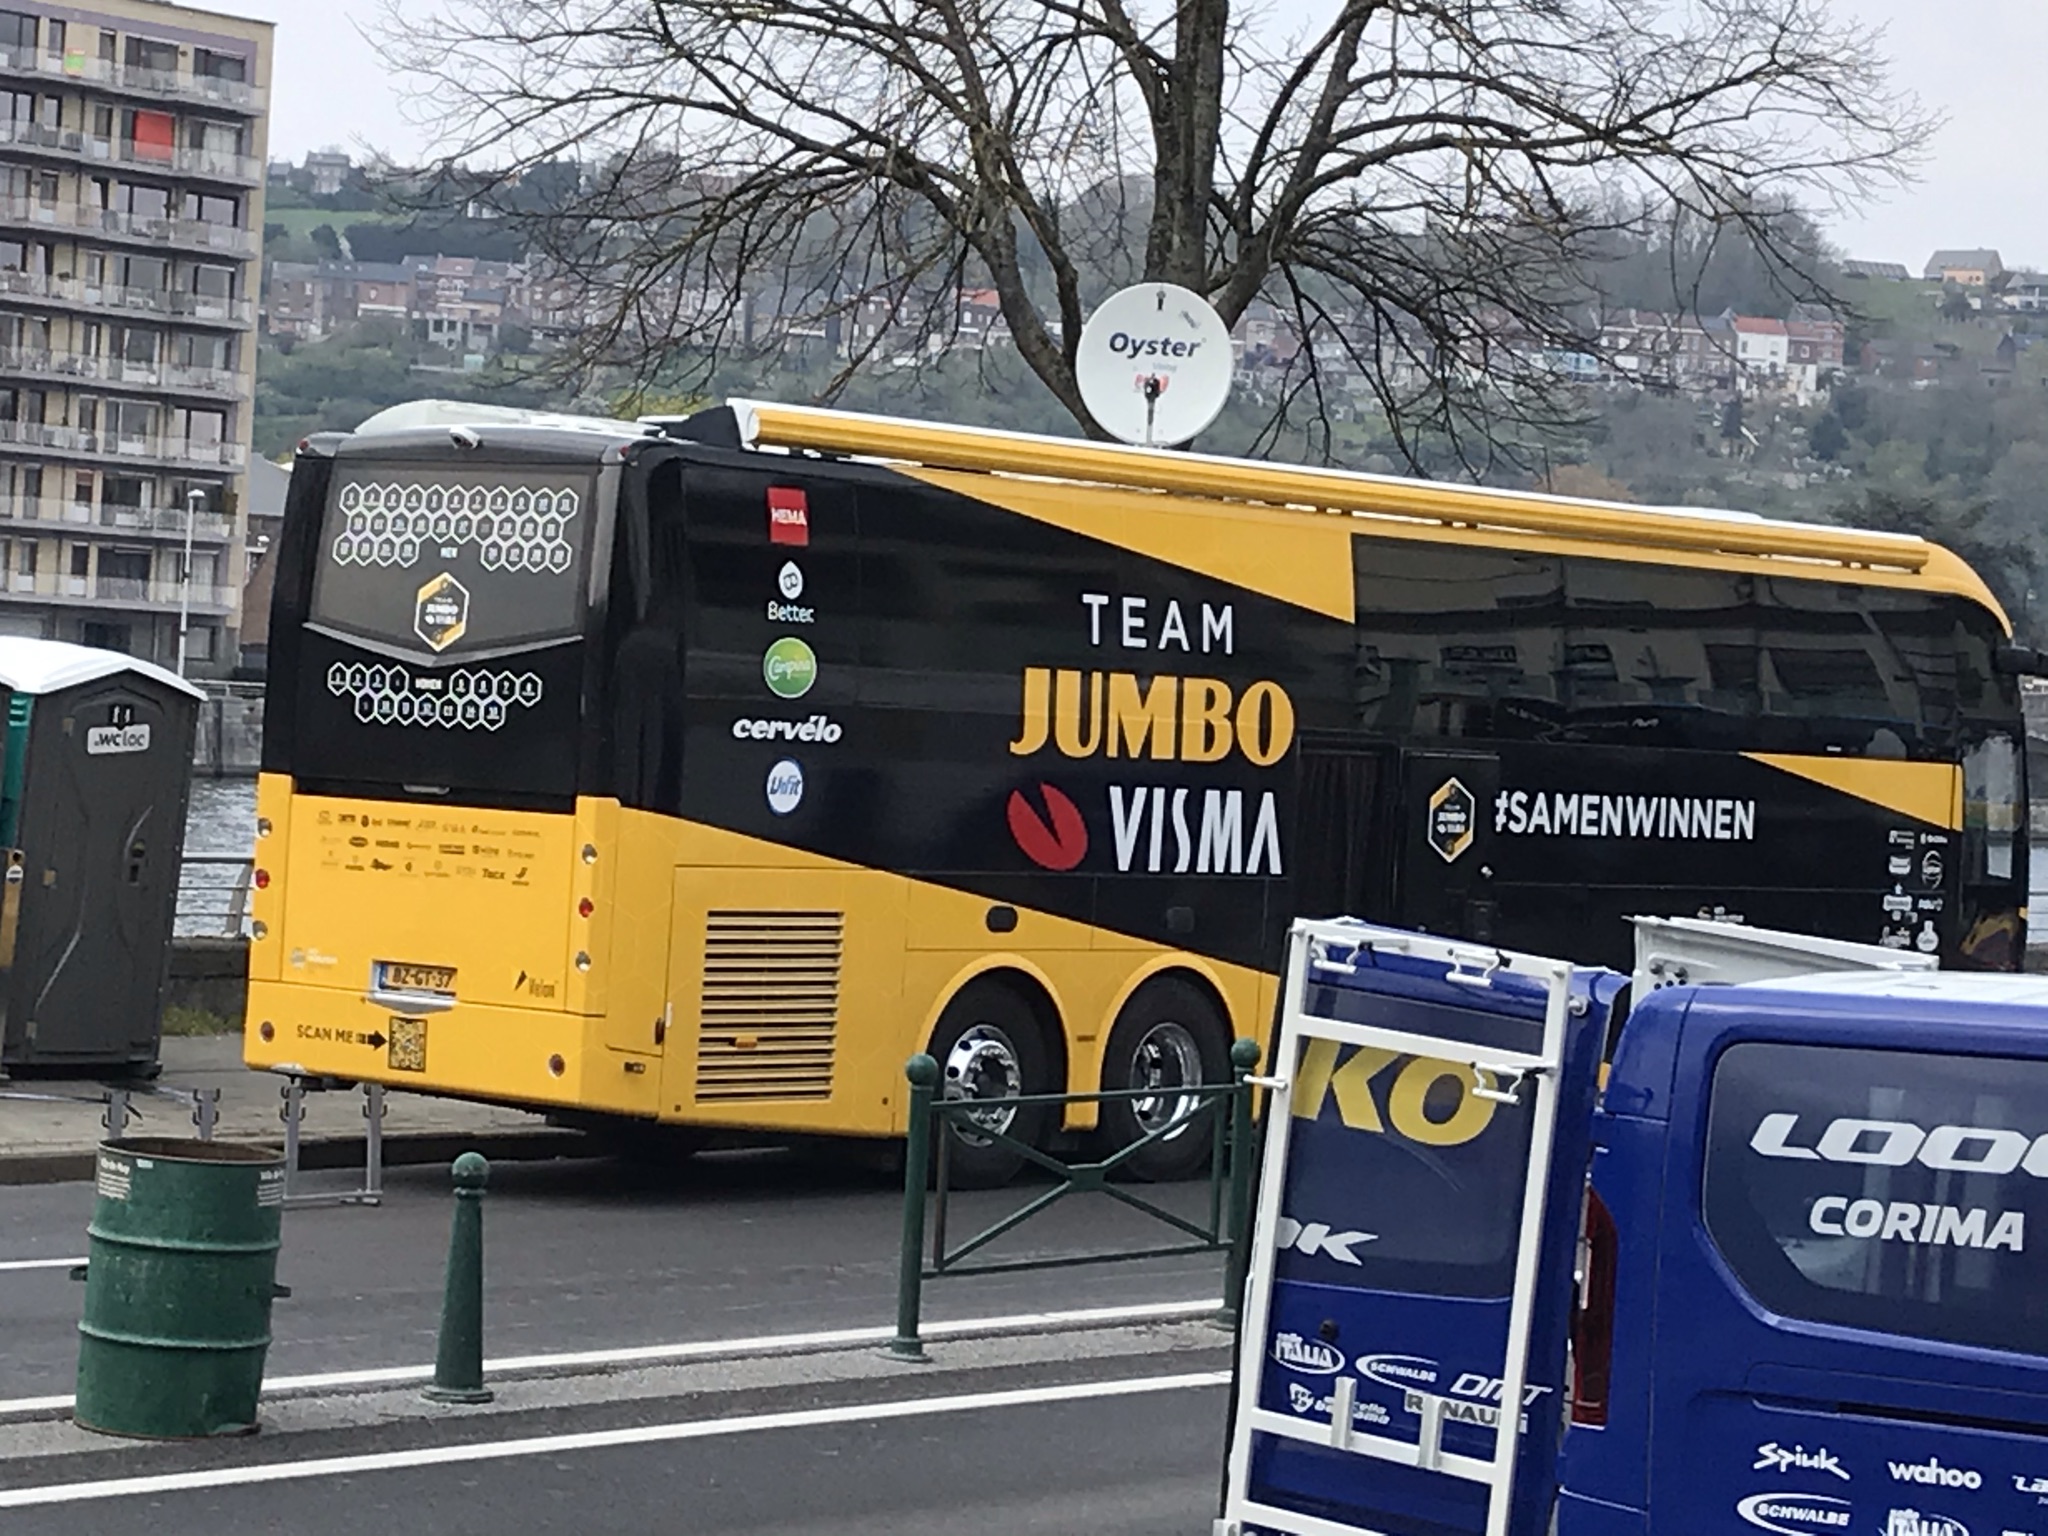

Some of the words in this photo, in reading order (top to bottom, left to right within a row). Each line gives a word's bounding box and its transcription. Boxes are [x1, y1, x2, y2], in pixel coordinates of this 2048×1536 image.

[1109, 332, 1201, 359] Oyster
[771, 507, 807, 526] HEMA
[767, 601, 814, 623] Better
[1082, 592, 1233, 654] TEAM
[733, 715, 842, 743] cervélo
[1009, 666, 1294, 767] JUMBO
[1109, 785, 1282, 875] VISMA
[1495, 790, 1756, 841] #SAMENWINNEN
[297, 1024, 331, 1042] SCAN
[336, 1028, 353, 1044] ME
[1750, 1113, 2048, 1178] LOO
[1809, 1196, 2025, 1251] CORIMA
[1370, 1361, 1437, 1383] SCHWALBE
[1888, 1457, 1982, 1489] wahoo
[1757, 1502, 1850, 1527] SCHWALBE
